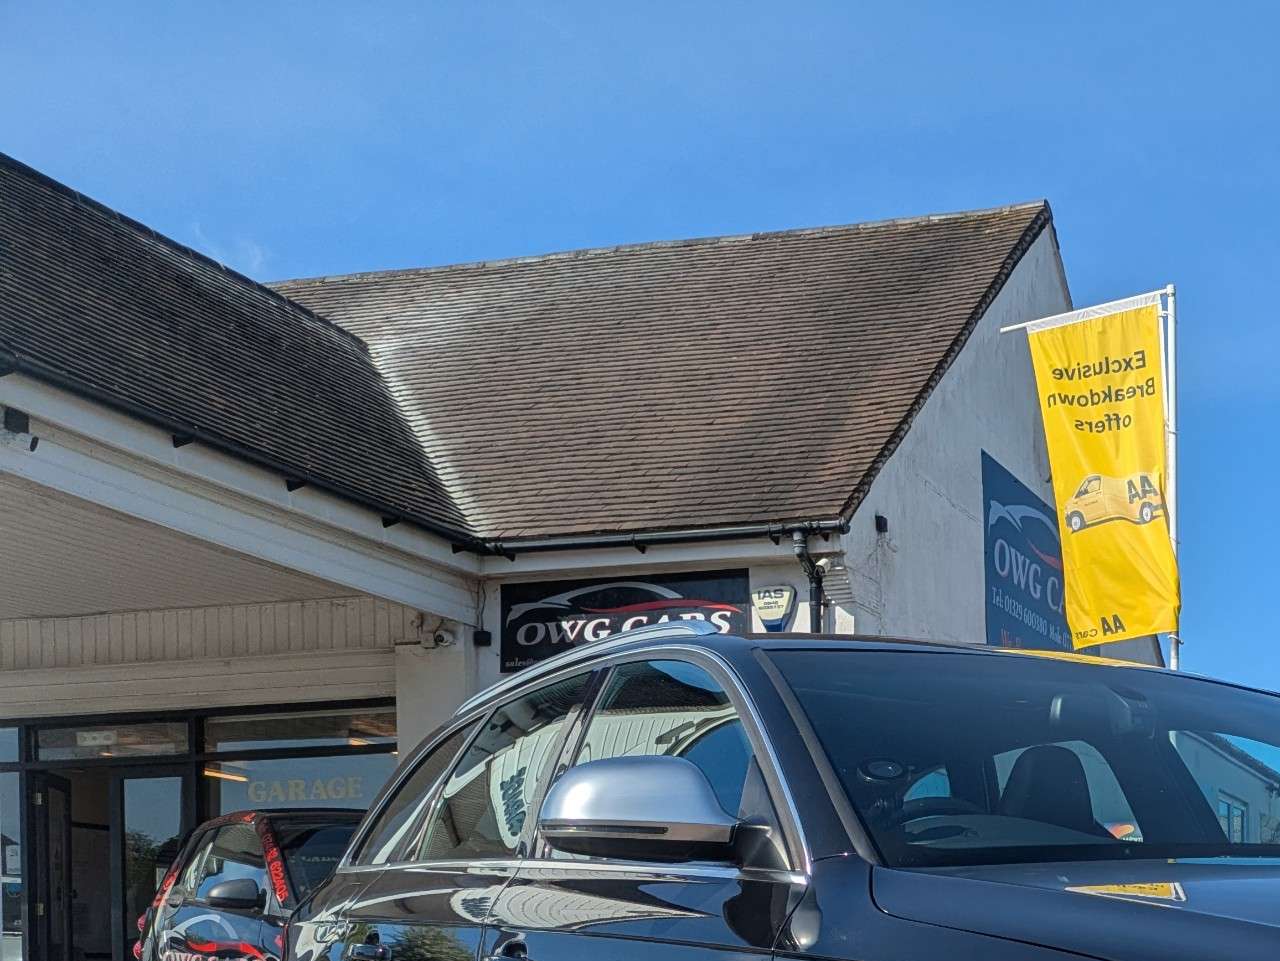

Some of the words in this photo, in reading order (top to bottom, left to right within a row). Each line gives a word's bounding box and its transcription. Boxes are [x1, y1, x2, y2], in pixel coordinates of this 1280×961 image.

[994, 538, 1043, 599] OWG
[757, 588, 784, 600] IAS
[516, 616, 611, 646] OWG
[247, 775, 363, 802] GARAGE
